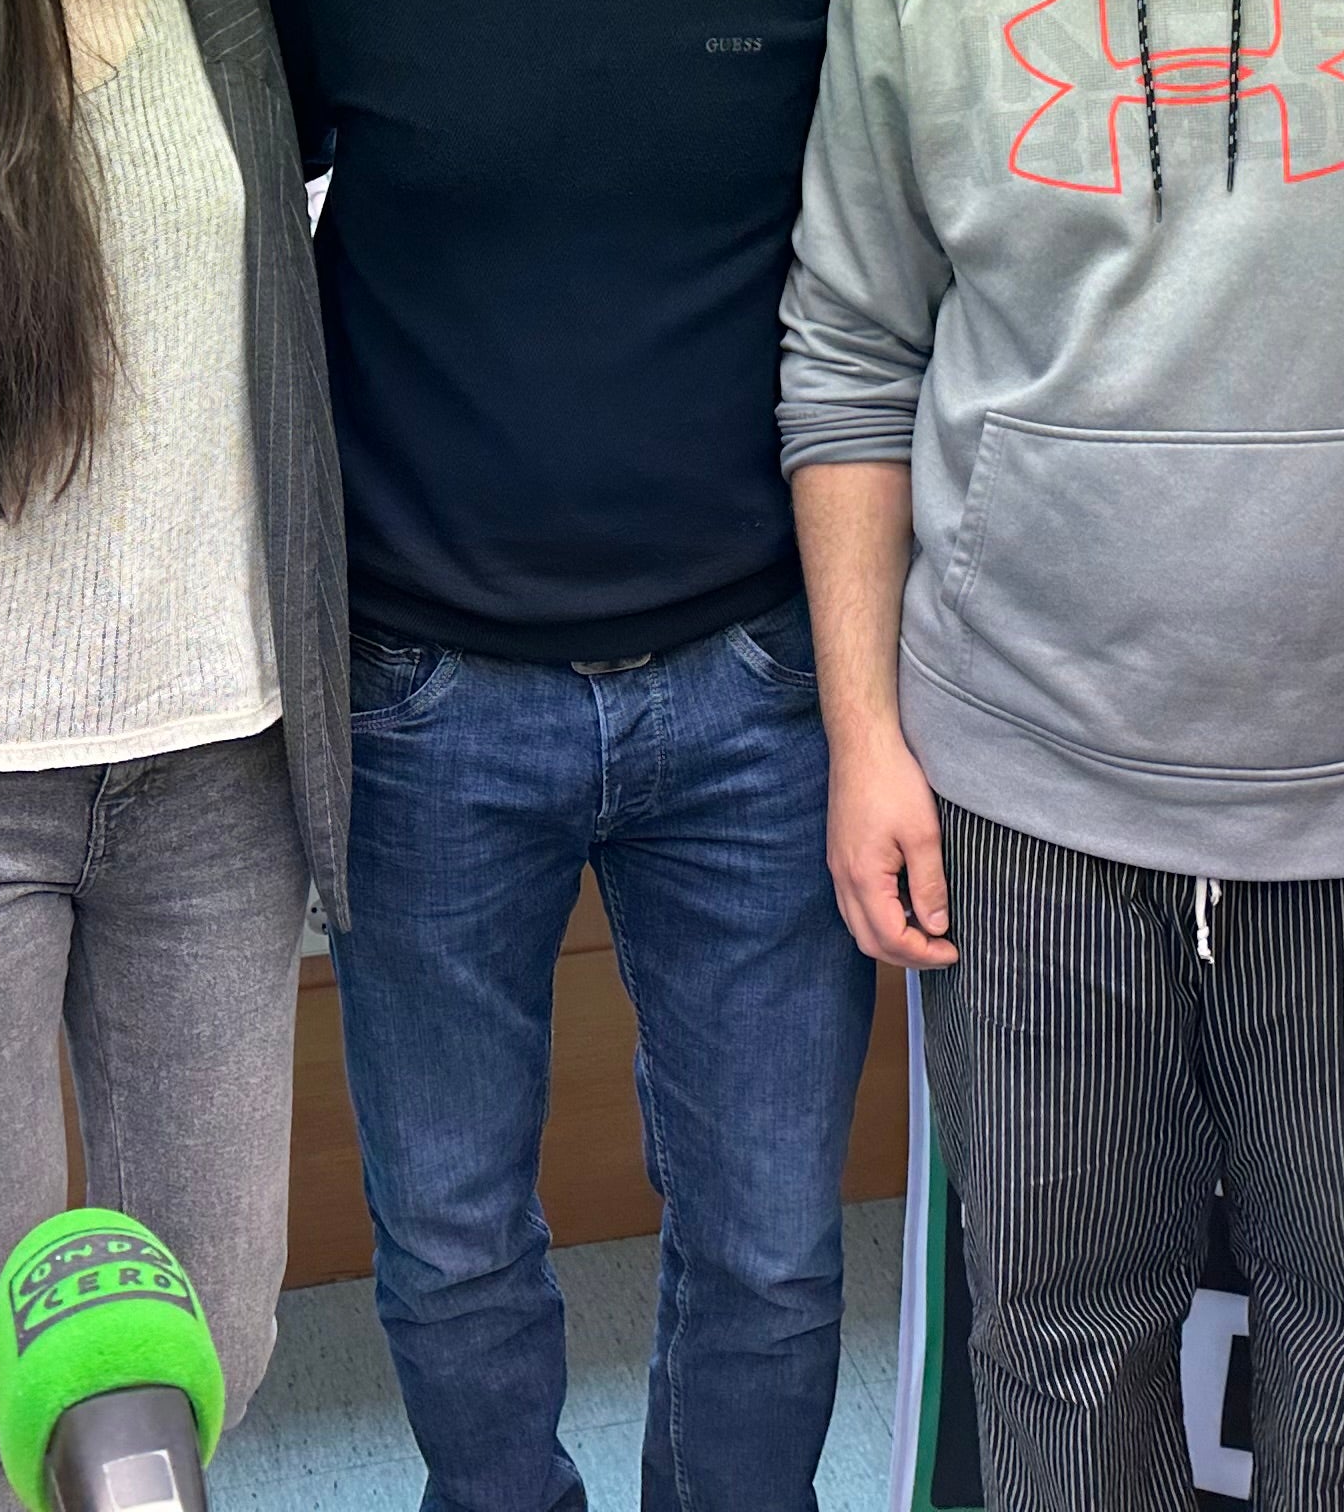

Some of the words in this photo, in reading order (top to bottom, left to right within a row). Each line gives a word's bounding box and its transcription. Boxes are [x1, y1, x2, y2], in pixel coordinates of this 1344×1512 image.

[705, 37, 763, 53] GUESS
[31, 1240, 162, 1283] ONDA
[43, 1267, 171, 1310] CERO
